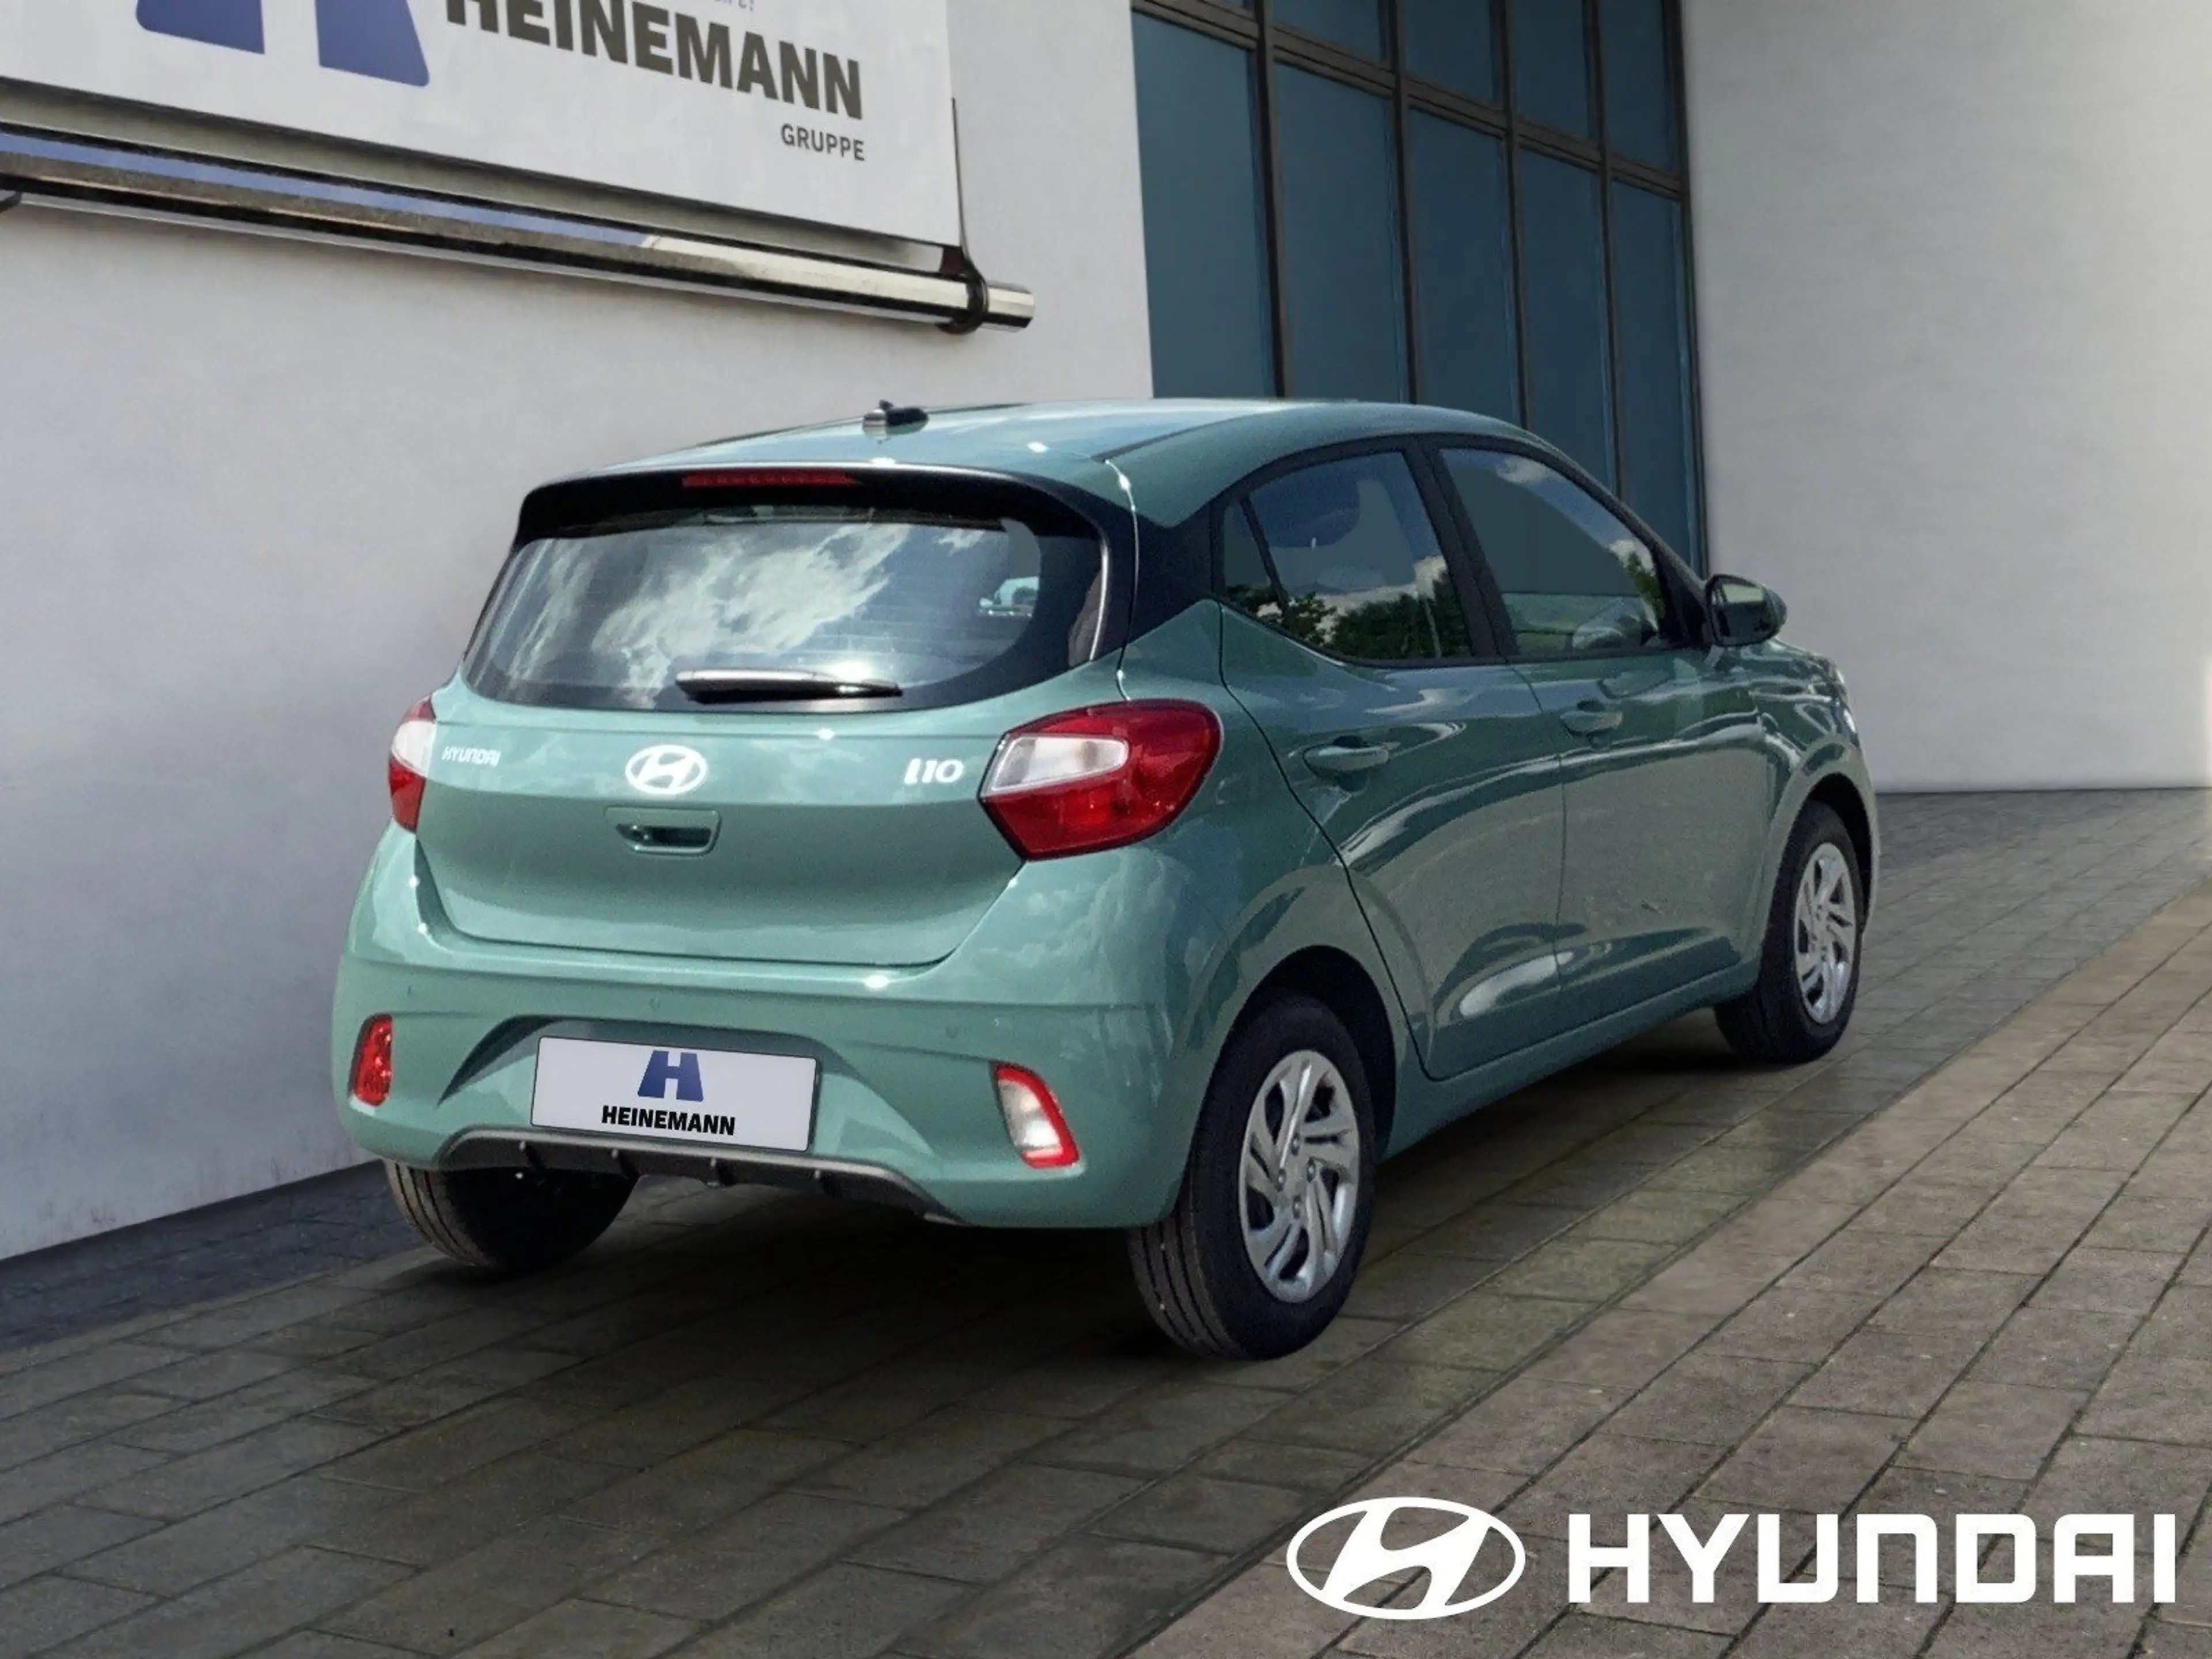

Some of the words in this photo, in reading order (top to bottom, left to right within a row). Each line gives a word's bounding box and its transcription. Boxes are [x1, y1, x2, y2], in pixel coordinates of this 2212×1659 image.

[781, 123, 865, 161] GRUPPE
[441, 746, 501, 767] HYUNDAI
[601, 1105, 735, 1136] HEINEMANN
